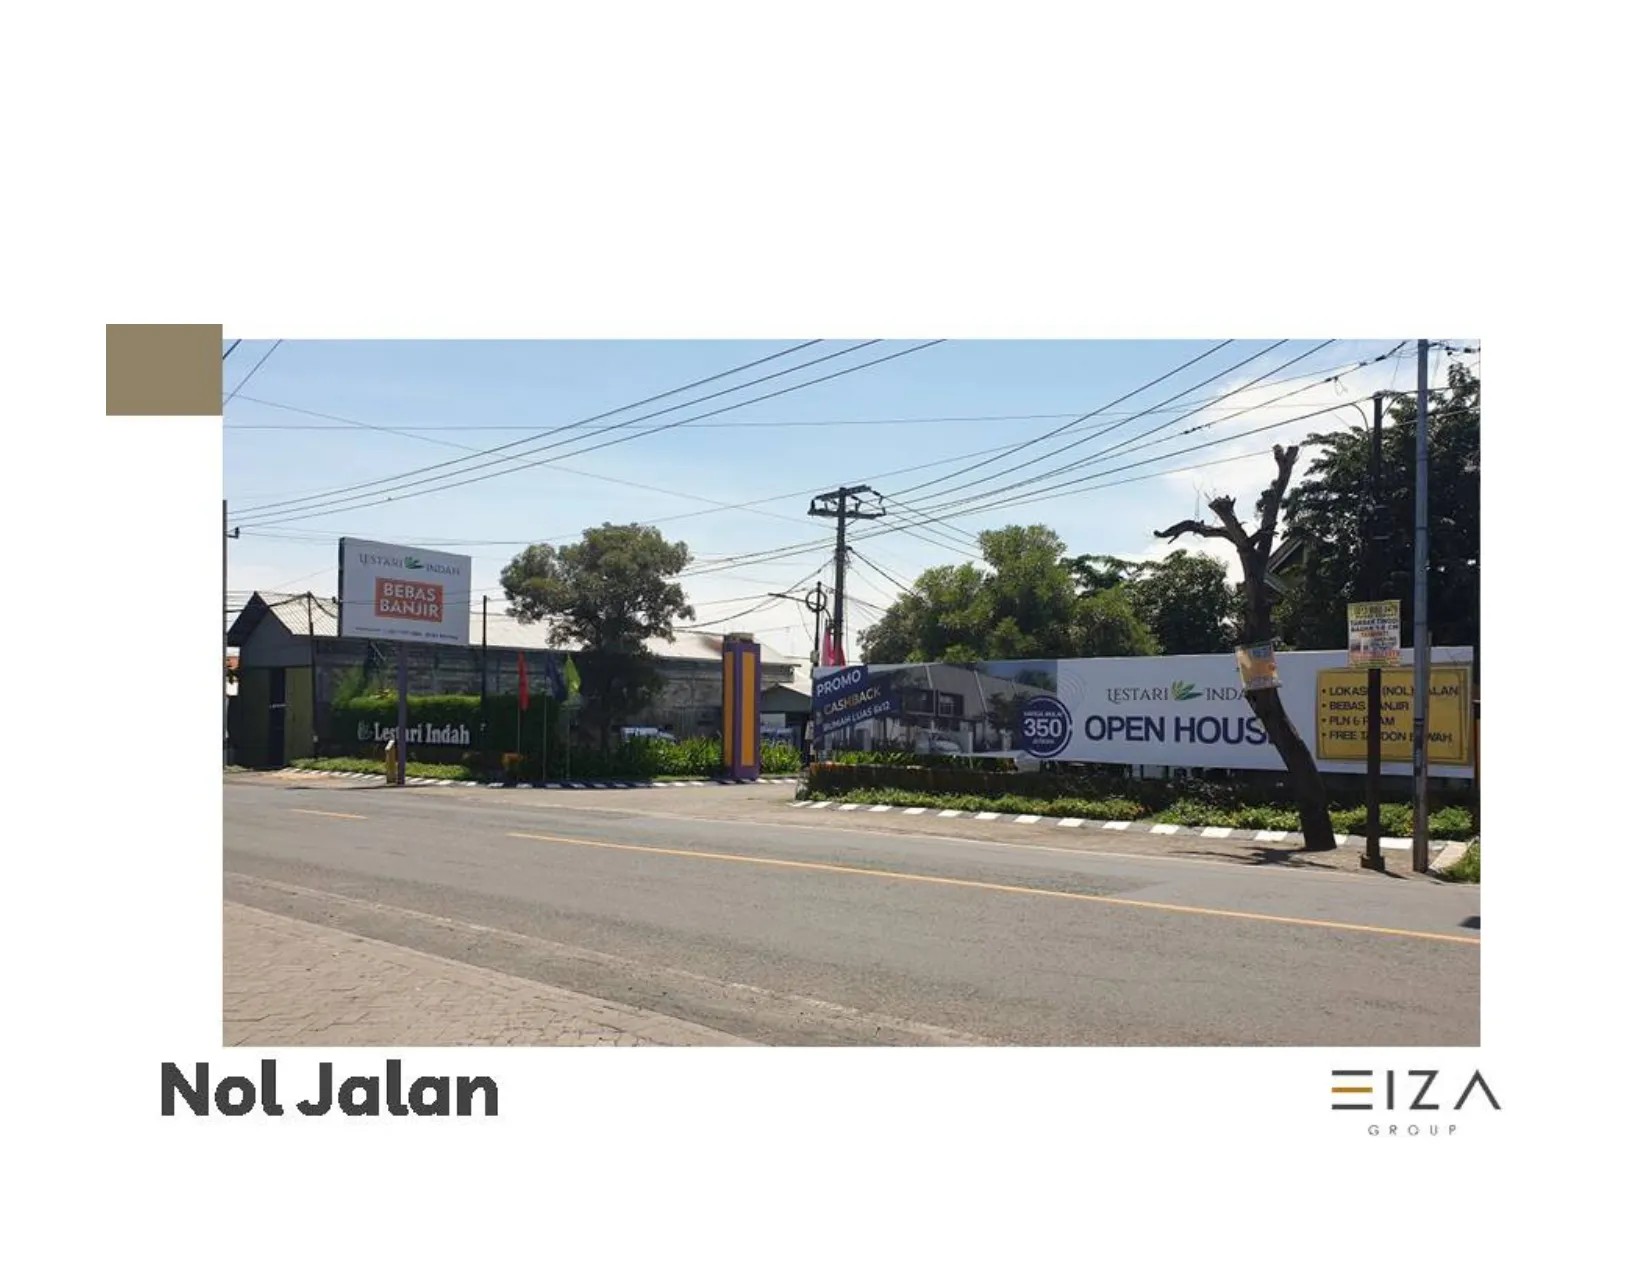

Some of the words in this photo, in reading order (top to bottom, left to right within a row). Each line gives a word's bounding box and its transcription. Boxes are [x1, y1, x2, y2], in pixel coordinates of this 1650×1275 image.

[426, 563, 460, 576] INDAH
[383, 582, 436, 602] BEBAS
[380, 599, 439, 618] BANJIR
[816, 669, 861, 697] PROMO
[1329, 685, 1369, 697] LOKAS
[823, 686, 881, 715] CASHBACK
[1105, 687, 1169, 705] LESTARI
[852, 706, 873, 722] LUAS
[1329, 701, 1366, 710] BEBAS
[1023, 718, 1062, 737] 350
[1085, 715, 1165, 742] OPEN
[1174, 716, 1268, 745] HOUS
[1329, 716, 1350, 726] PLN
[426, 723, 471, 745] Indah
[1329, 731, 1358, 740] FREE
